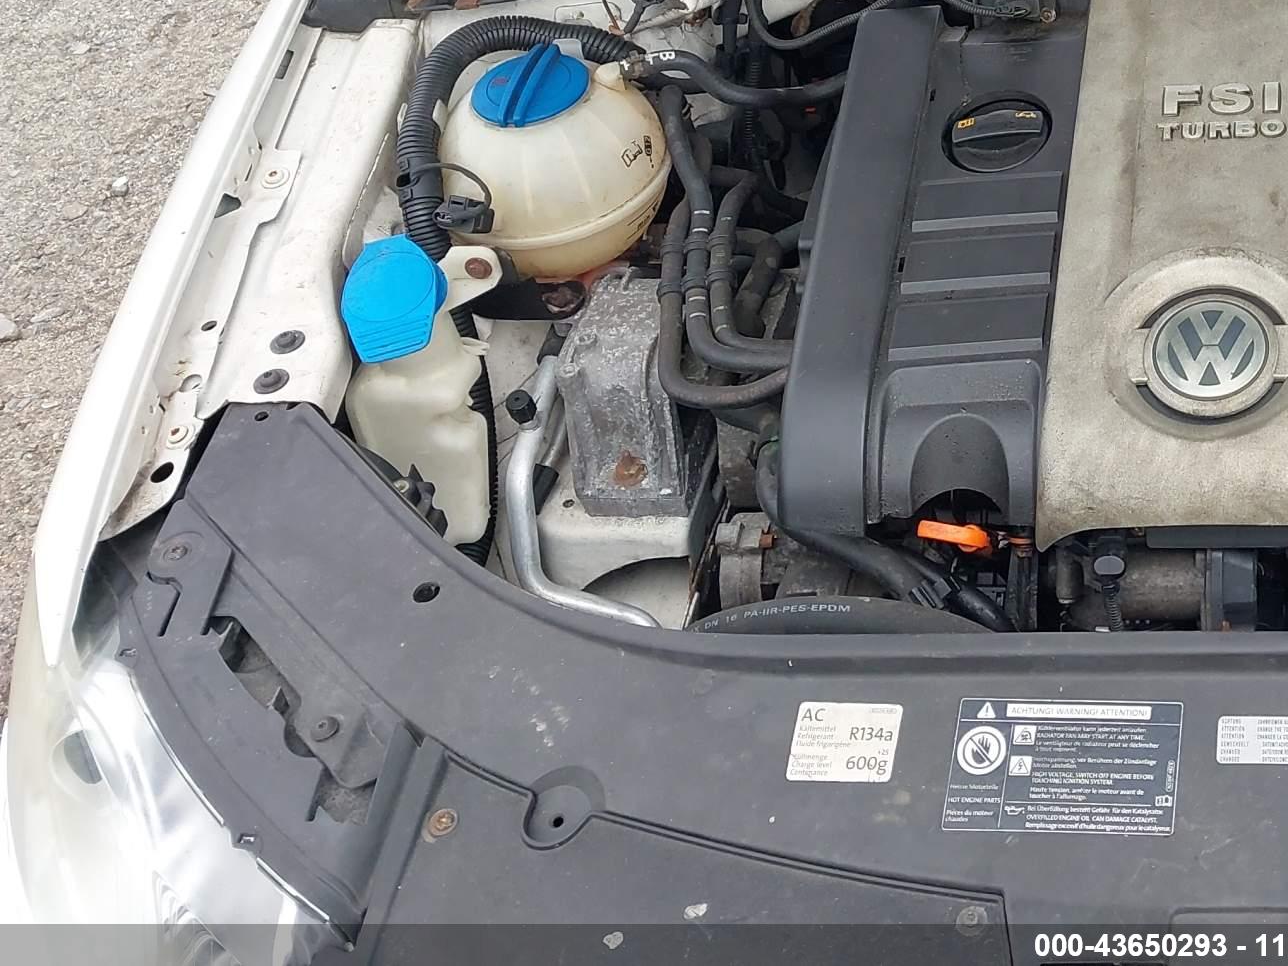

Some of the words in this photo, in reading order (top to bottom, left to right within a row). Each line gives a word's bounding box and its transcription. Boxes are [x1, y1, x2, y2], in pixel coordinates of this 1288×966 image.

[1161, 81, 1281, 116] FSI
[1156, 120, 1287, 141] TURBO
[802, 708, 826, 722] AC
[850, 726, 893, 741] R134a
[846, 756, 888, 775] 600g
